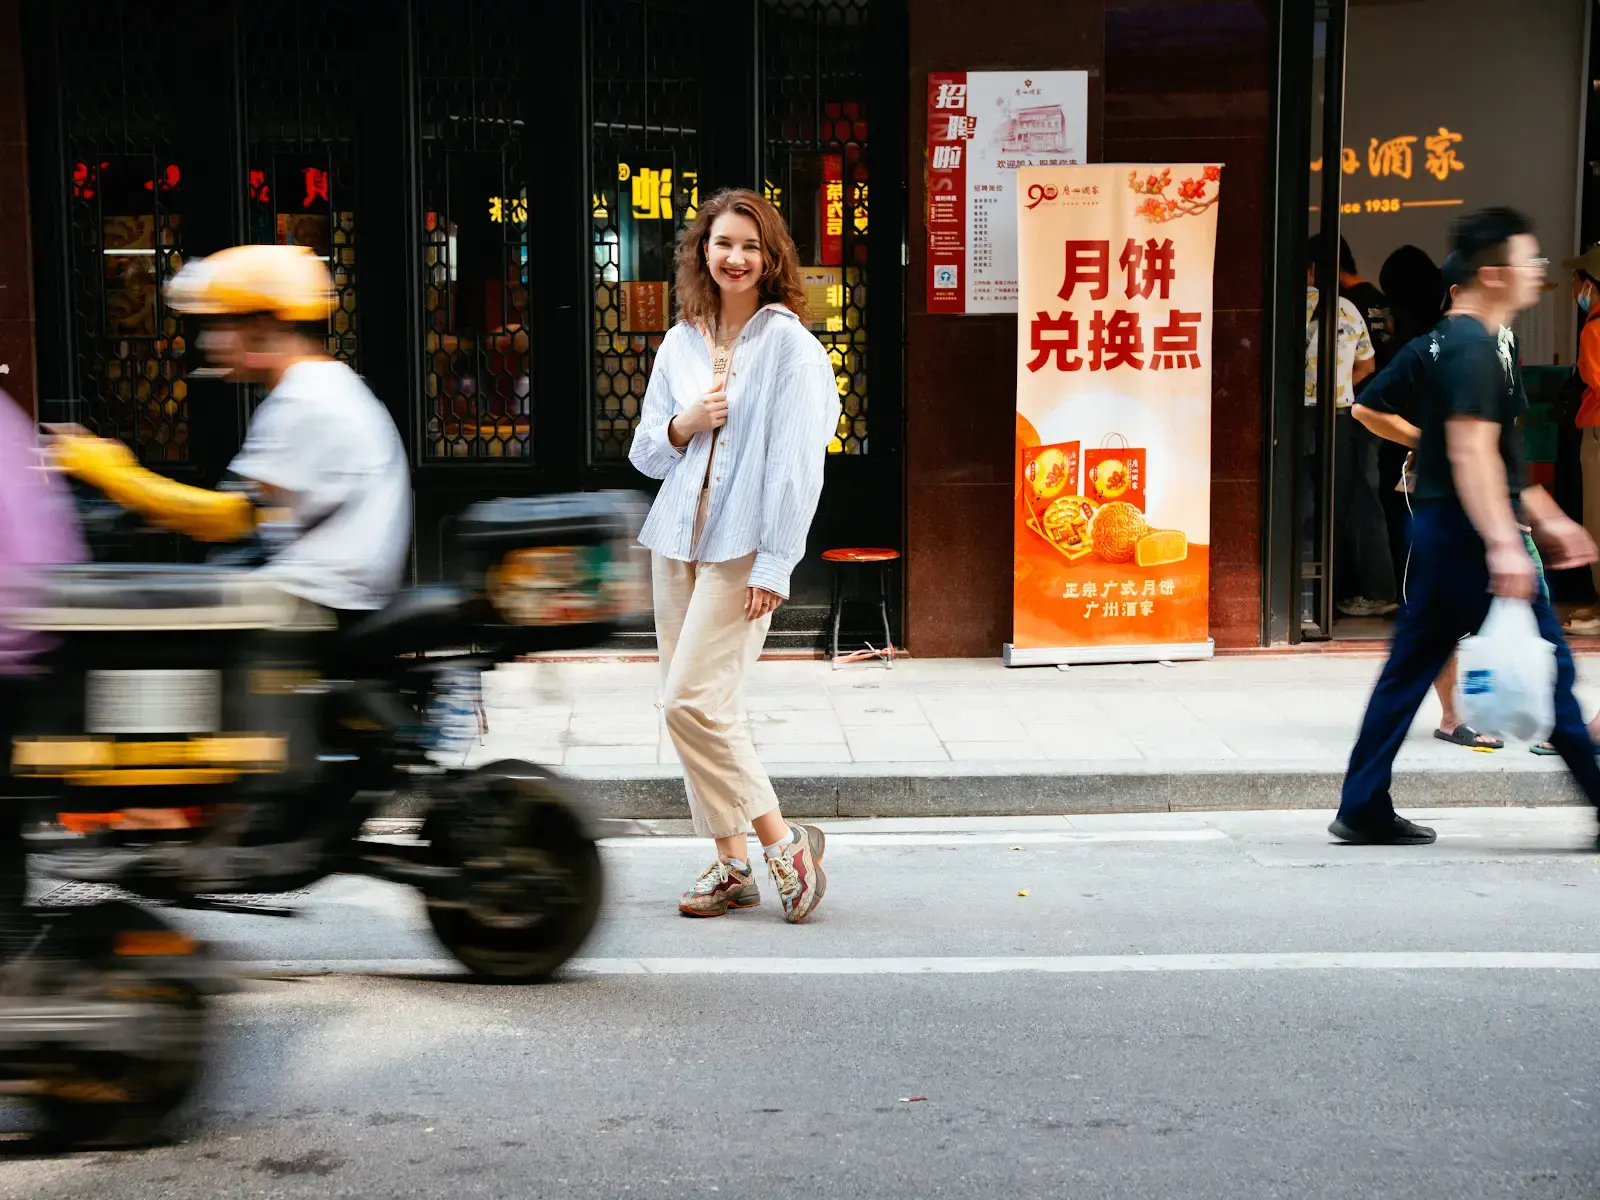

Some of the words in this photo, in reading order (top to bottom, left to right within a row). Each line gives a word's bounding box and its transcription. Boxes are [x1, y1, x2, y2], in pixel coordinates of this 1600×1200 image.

[933, 84, 977, 168] 招聘啦
[1057, 238, 1175, 301] 月饼
[1026, 309, 1202, 373] 兑换点
[1062, 579, 1176, 599] 正宗广式月饼
[1083, 600, 1154, 618] 广州酒家
